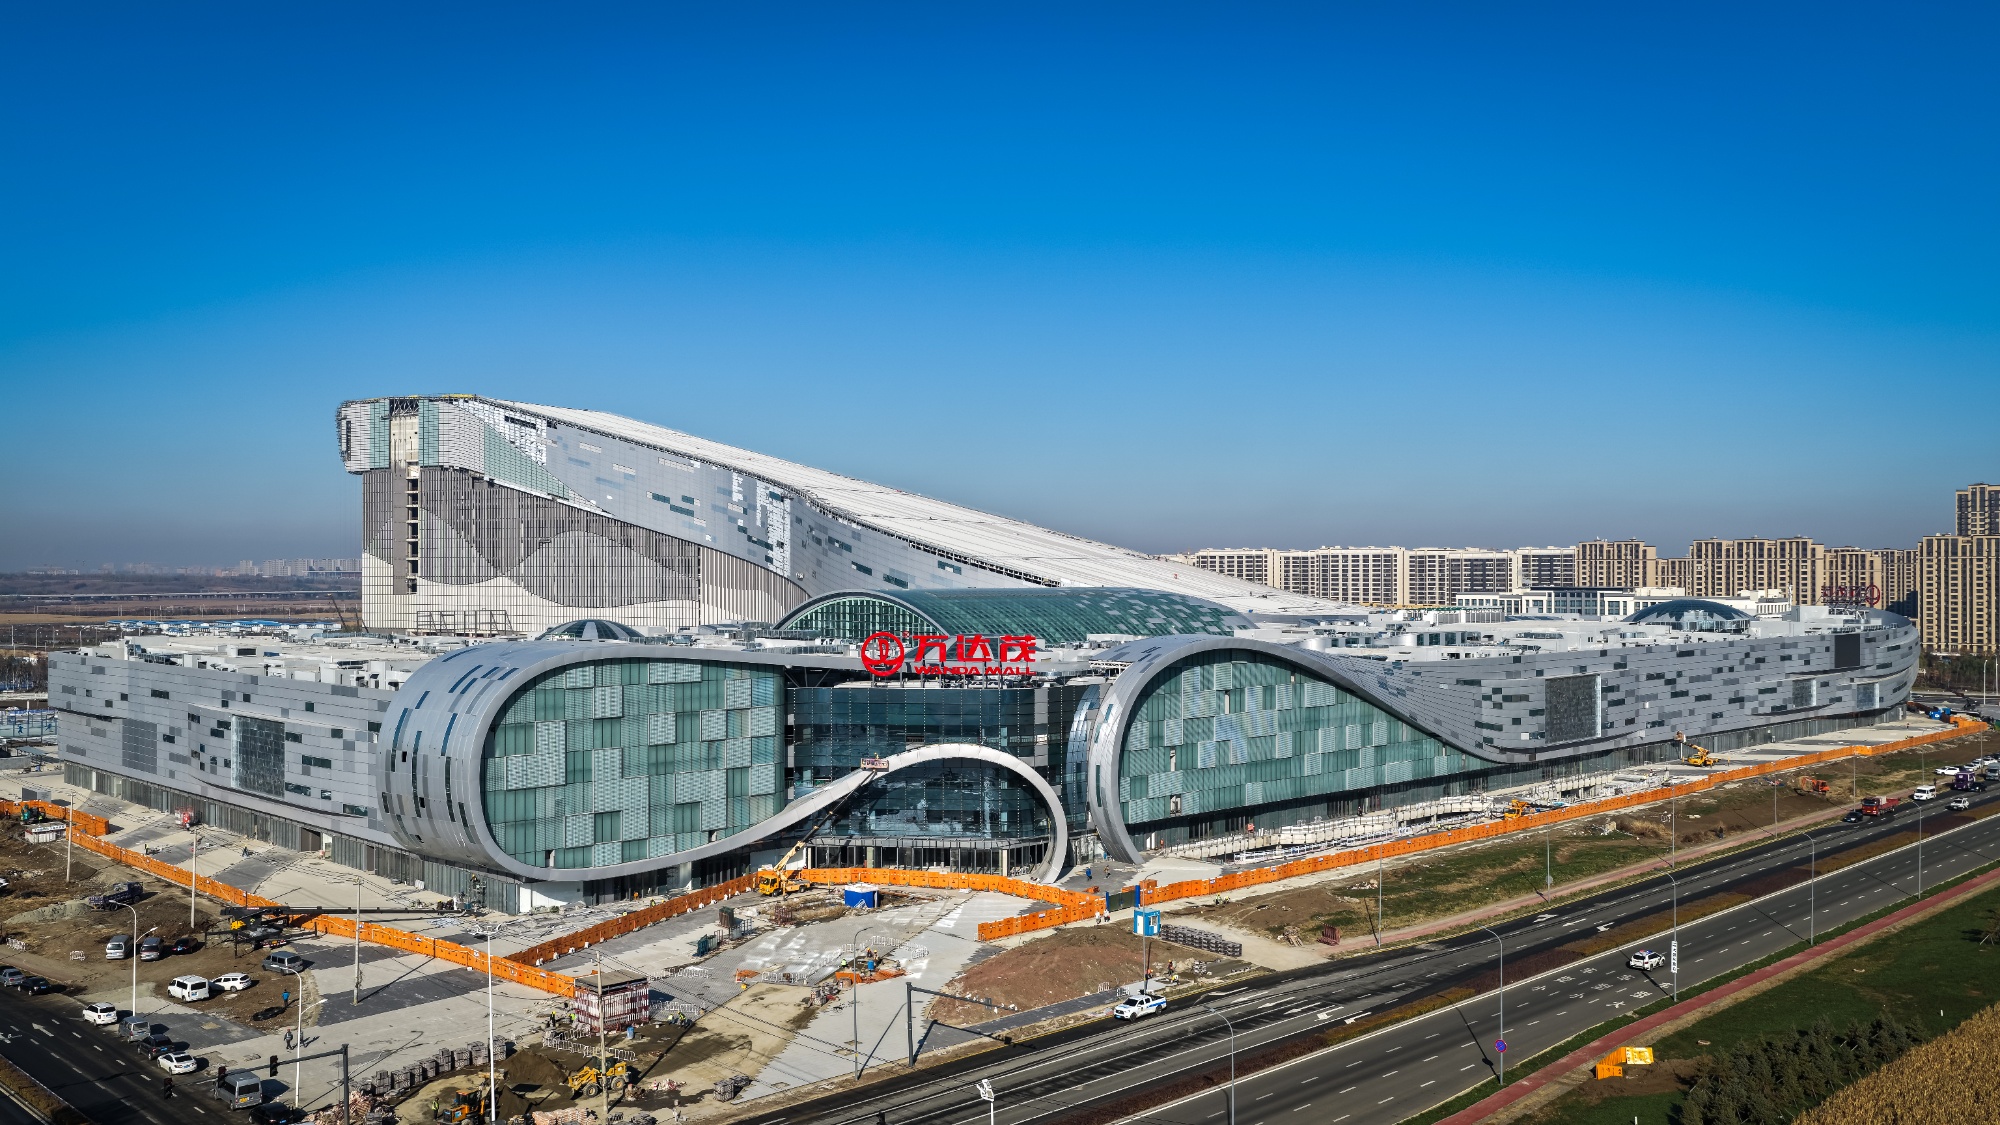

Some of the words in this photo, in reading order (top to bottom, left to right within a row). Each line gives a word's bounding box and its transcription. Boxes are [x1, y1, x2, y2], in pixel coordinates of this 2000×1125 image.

[912, 634, 1036, 662] 万达茂
[914, 666, 982, 675] WANDA
[985, 666, 1037, 675] MALL
